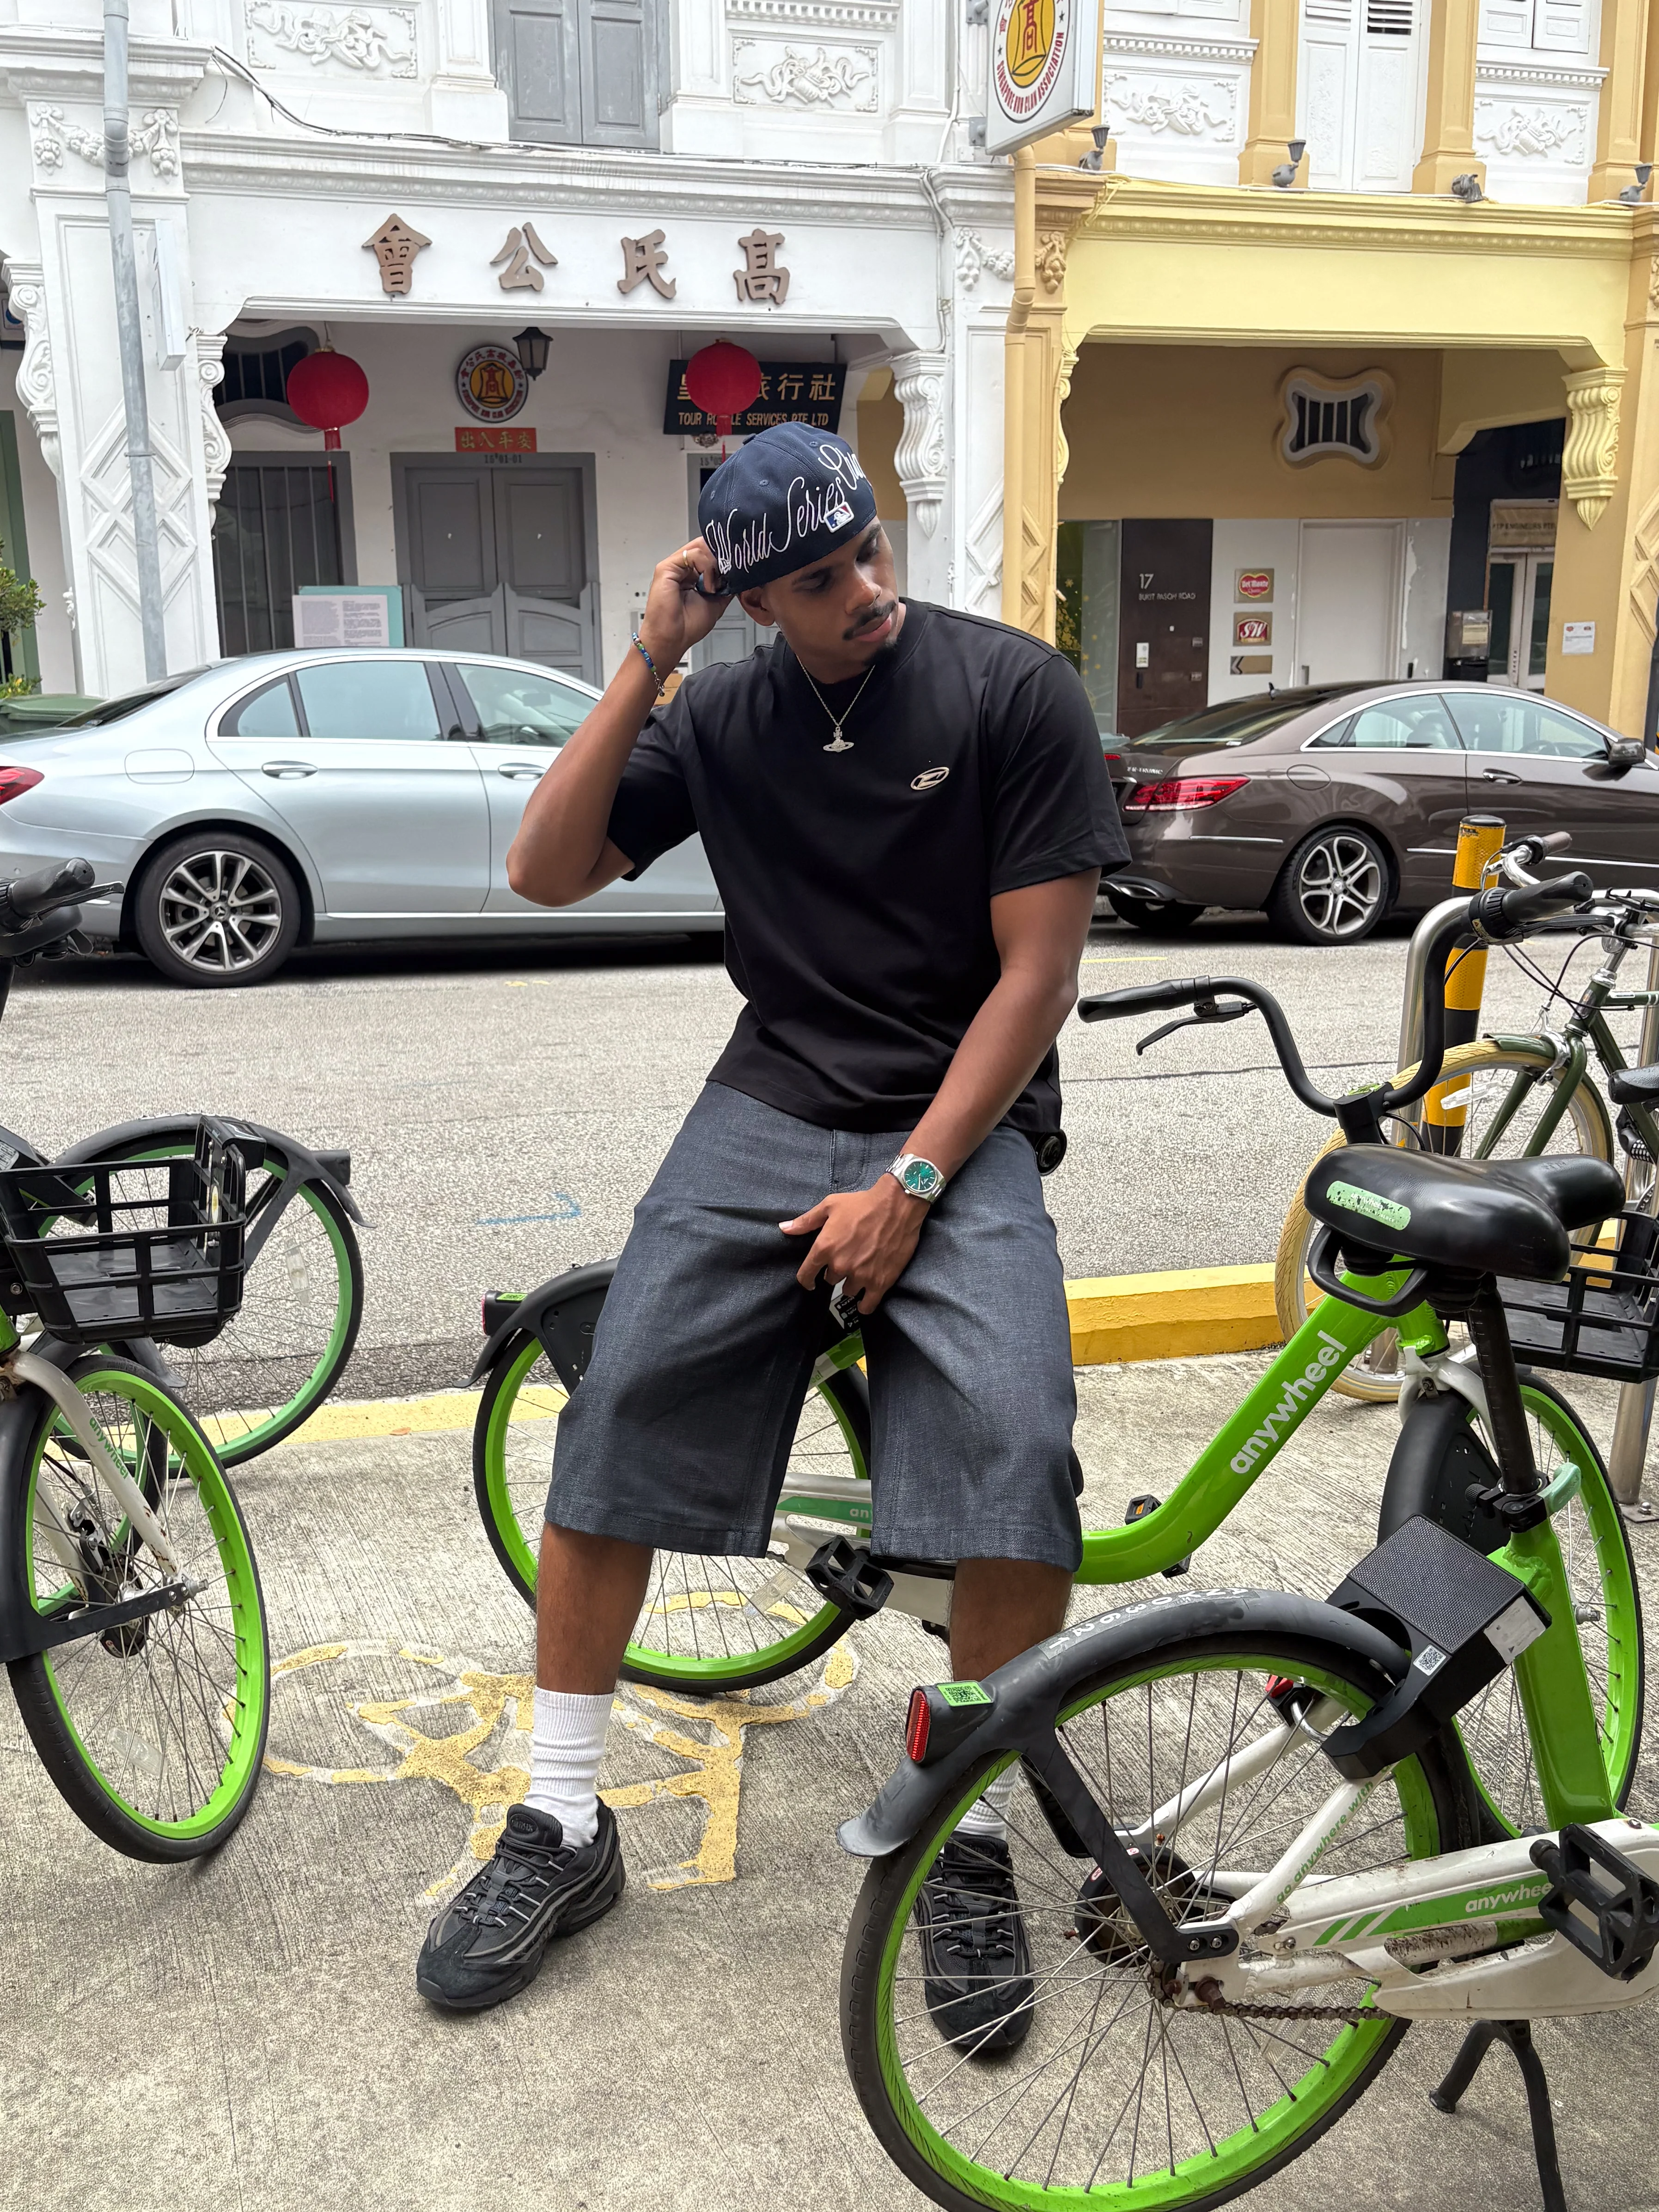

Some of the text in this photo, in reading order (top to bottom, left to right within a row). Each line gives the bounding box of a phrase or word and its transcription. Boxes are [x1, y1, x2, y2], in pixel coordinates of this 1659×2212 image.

[1037, 31, 1065, 102] ASSOCIATION
[460, 430, 531, 450] 出入平安
[678, 412, 702, 426] TOUR
[746, 412, 787, 426] SERVICES
[812, 413, 829, 426] LTD
[705, 477, 846, 574] World Series
[1139, 573, 1154, 589] 17
[1230, 1330, 1348, 1474] anywheel
[1276, 1781, 1373, 1904] go anywhere with
[1465, 1882, 1554, 1913] anywhee
